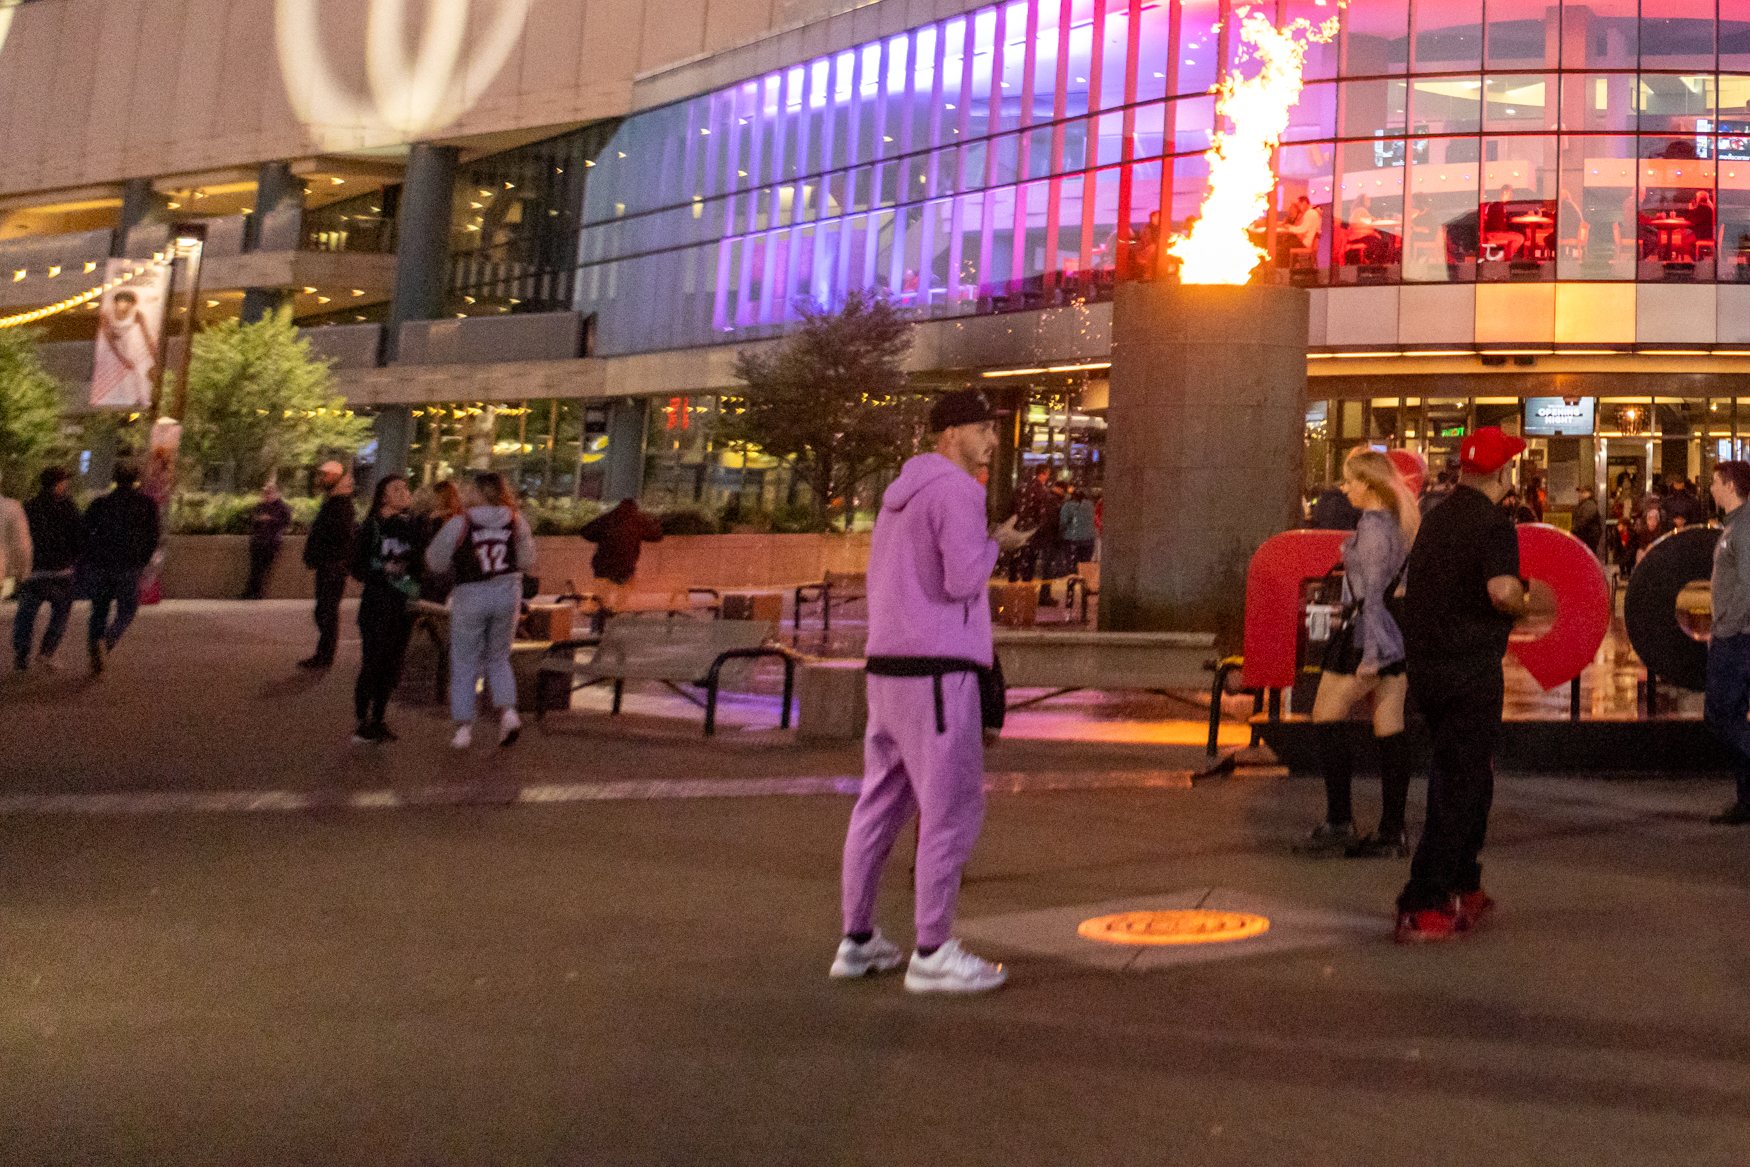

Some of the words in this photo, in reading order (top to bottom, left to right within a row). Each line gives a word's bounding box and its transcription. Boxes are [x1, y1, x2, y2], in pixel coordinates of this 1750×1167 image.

[1538, 408, 1580, 417] OPENING
[1544, 416, 1573, 424] NIGHT
[477, 543, 510, 573] 12
